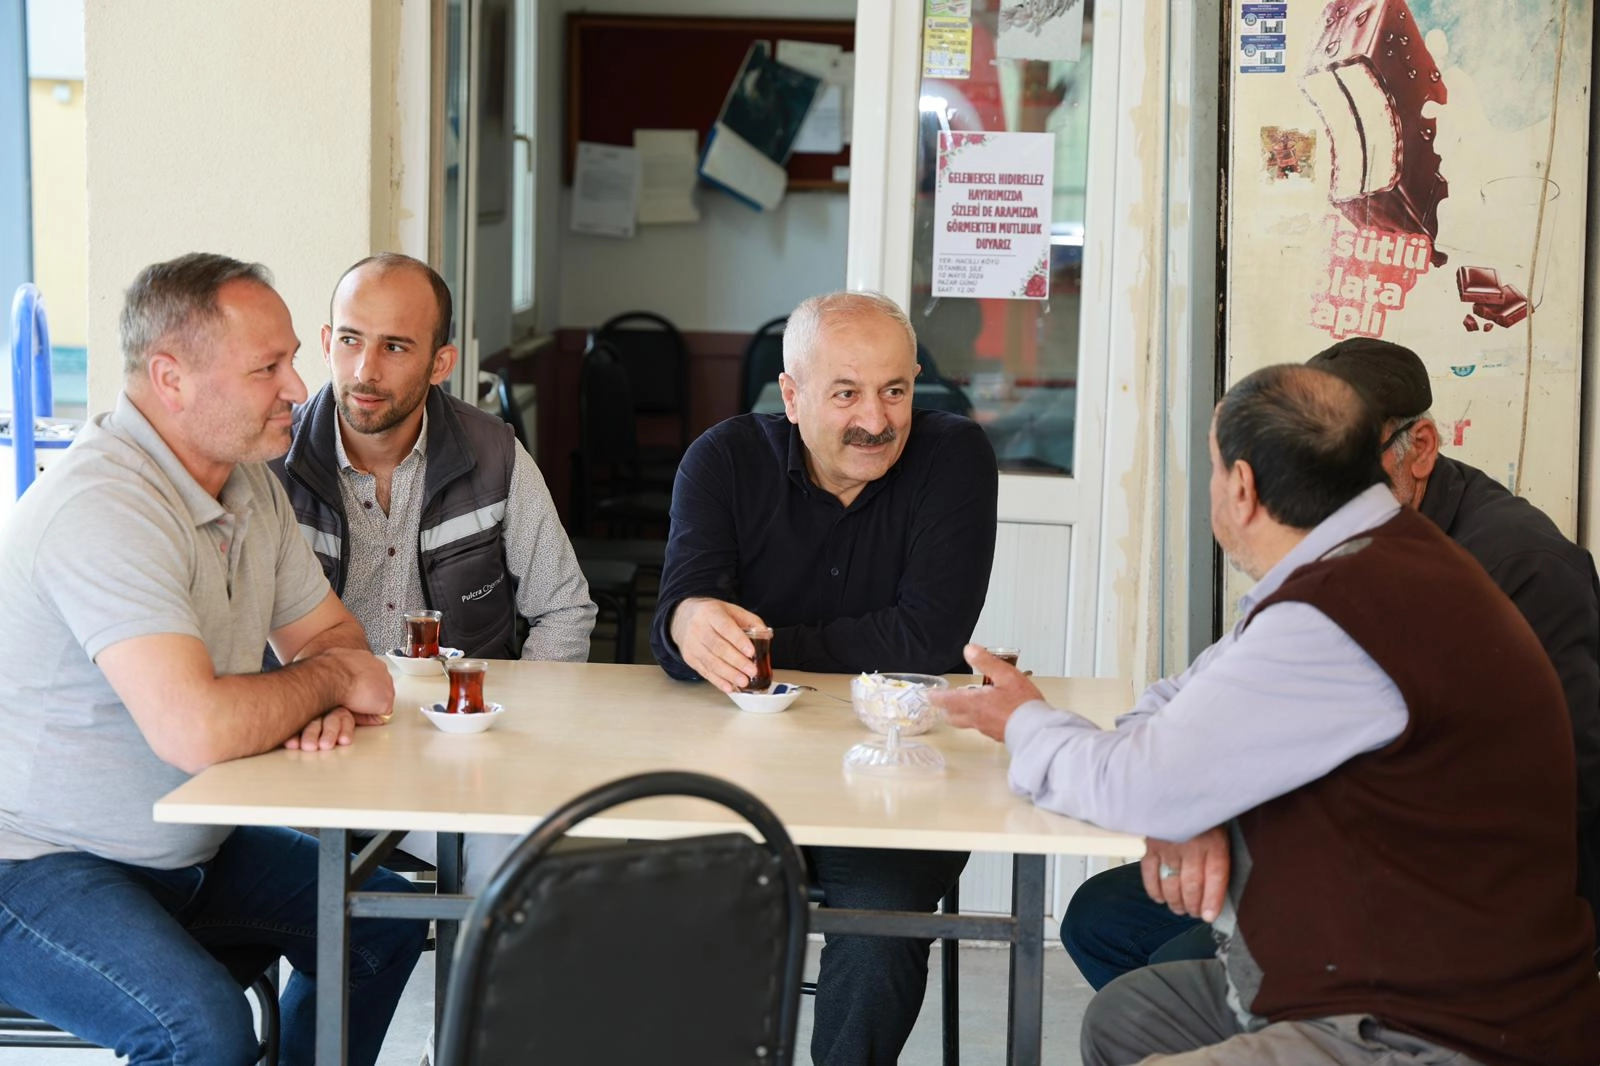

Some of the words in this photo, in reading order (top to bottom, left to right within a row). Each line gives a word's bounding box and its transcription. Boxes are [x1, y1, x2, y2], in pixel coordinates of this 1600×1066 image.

[948, 172, 997, 184] GELENEKSEL
[998, 174, 1044, 186] HIDIRELLEZ
[968, 189, 1022, 201] HAYIRIMIZDA
[952, 202, 980, 216] SİZLERİ
[982, 206, 992, 216] DE
[994, 206, 1038, 218] ARAMIZDA
[946, 218, 996, 233] GÖRMEKTEN
[998, 222, 1042, 234] MUTLULUK
[976, 238, 1012, 250] DUYARIZ
[1334, 229, 1428, 270] sütlü
[461, 589, 482, 603] Pulcra
